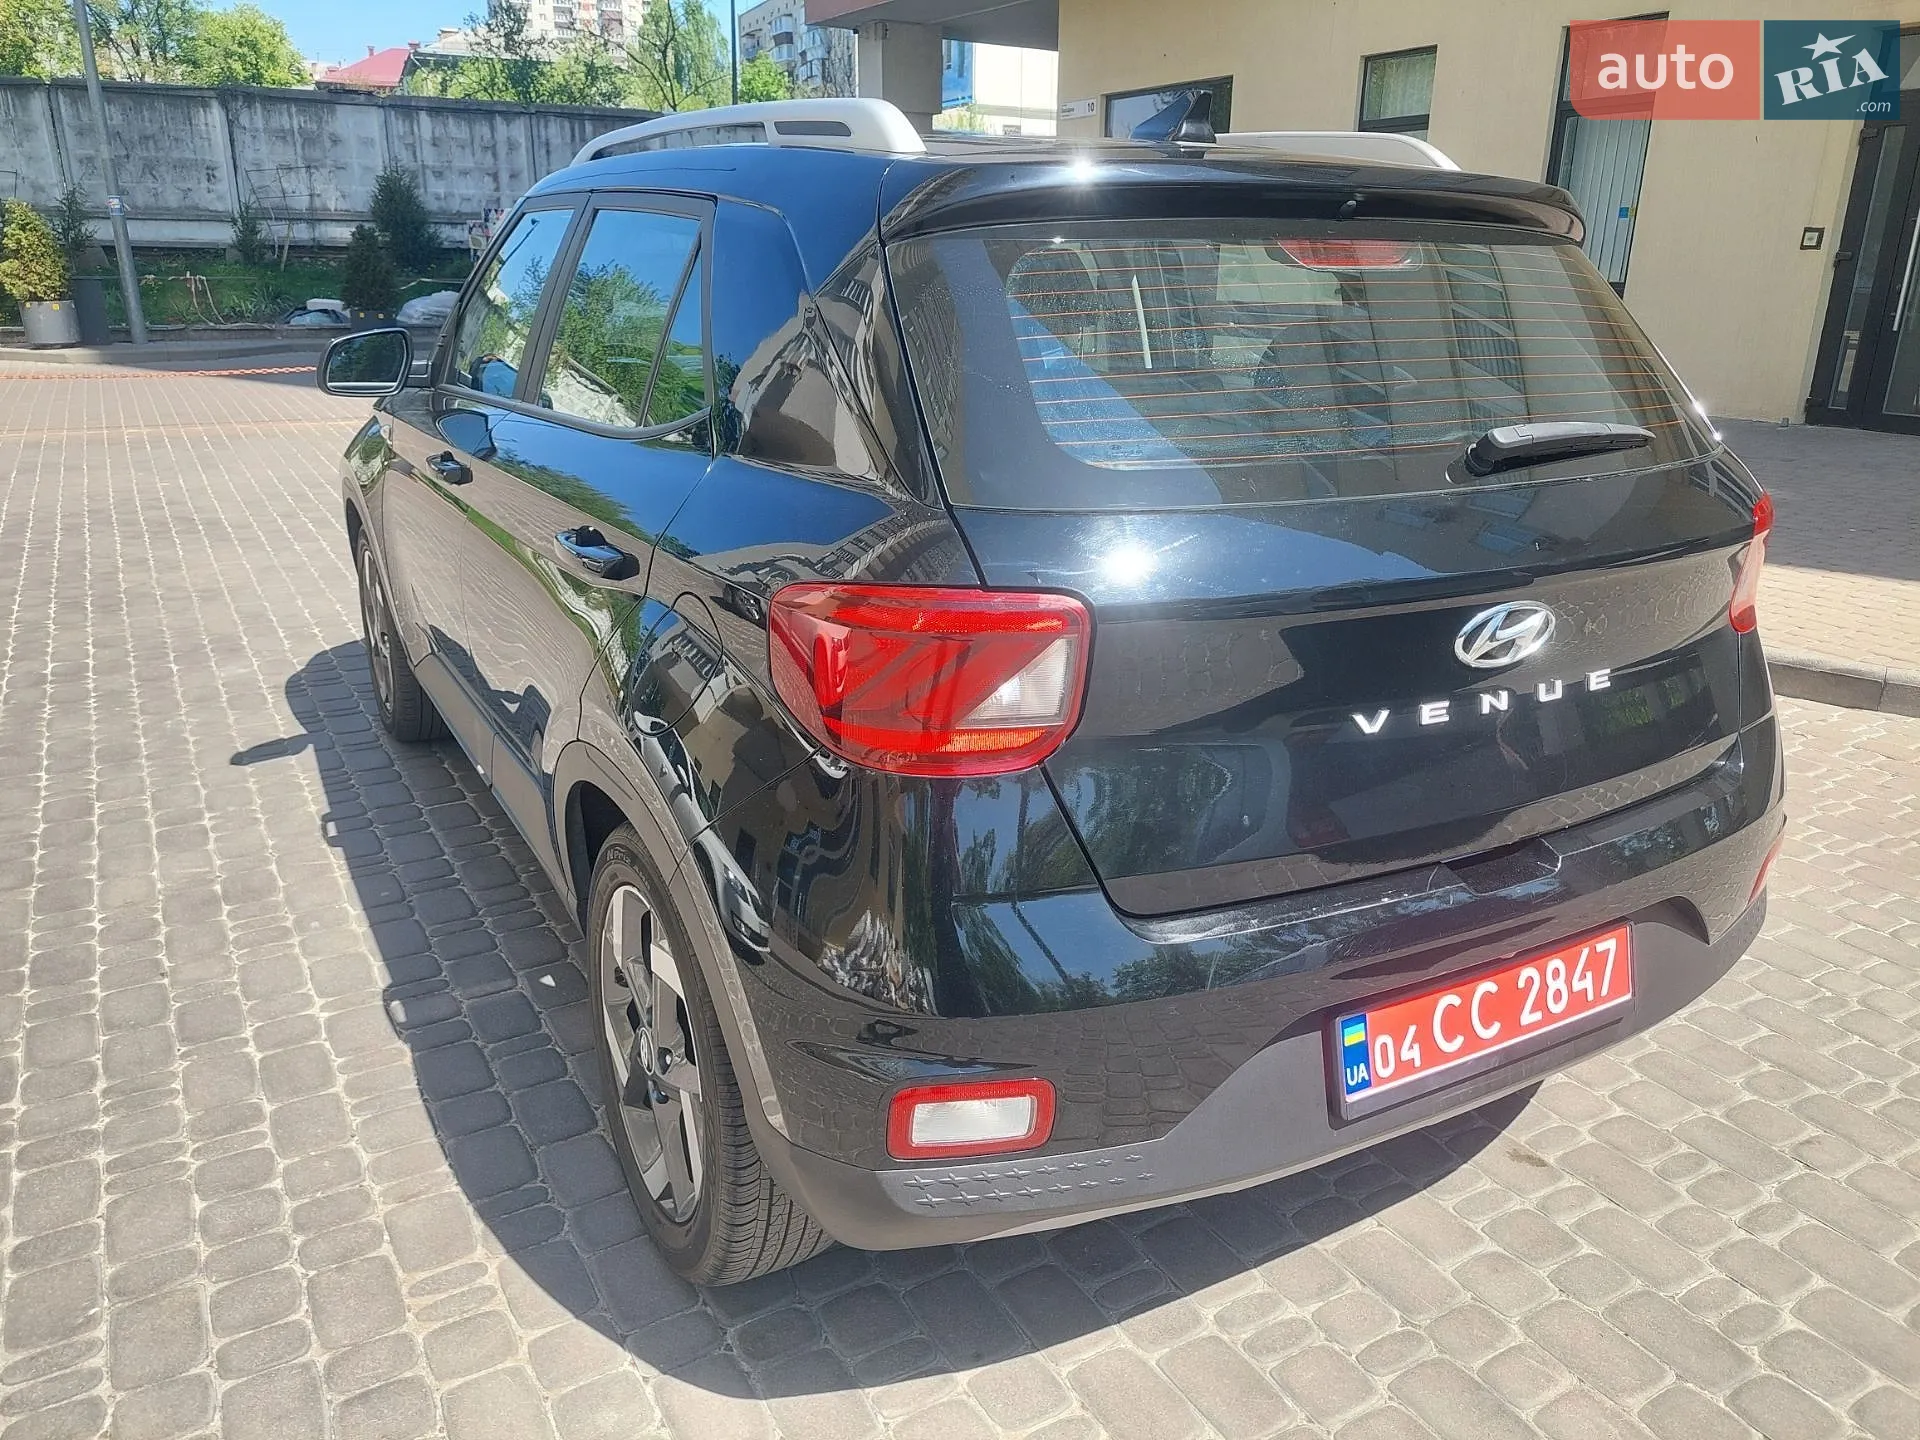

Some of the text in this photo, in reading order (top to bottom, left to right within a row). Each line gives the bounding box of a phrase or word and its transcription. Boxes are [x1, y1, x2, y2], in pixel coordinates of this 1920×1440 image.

[1087, 102, 1095, 112] 10
[1352, 668, 1611, 734] VENUE
[1374, 937, 1617, 1078] 04 CC 2847
[1346, 1062, 1369, 1086] UA
